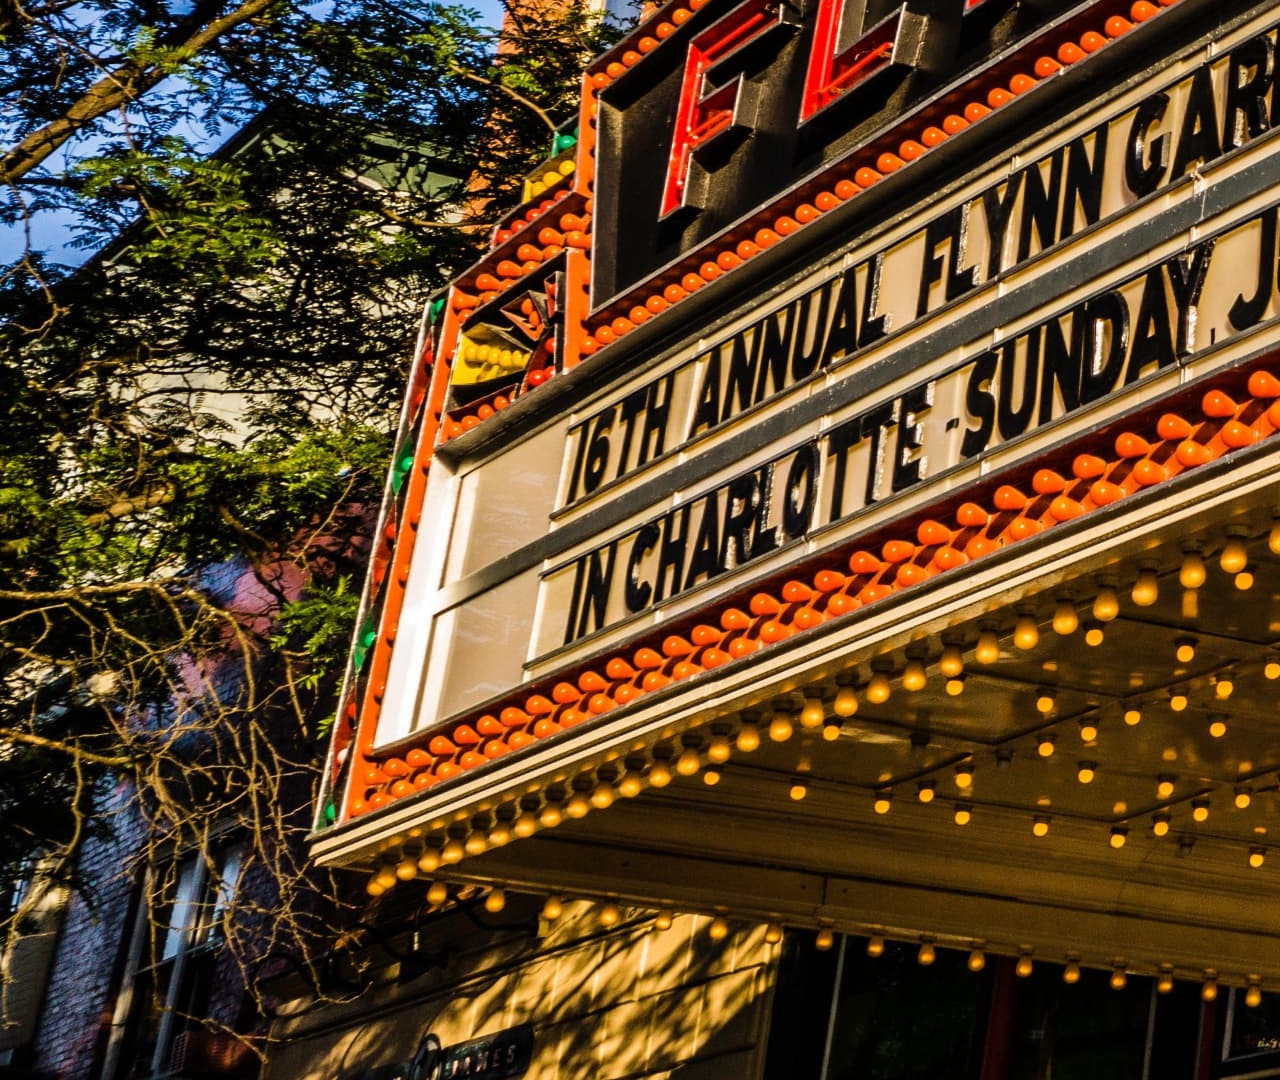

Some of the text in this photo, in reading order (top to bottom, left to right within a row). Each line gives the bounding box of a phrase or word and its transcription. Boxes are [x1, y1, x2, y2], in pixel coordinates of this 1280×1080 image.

[565, 373, 674, 506] 16TH
[692, 252, 890, 431] ANNUAL
[916, 126, 1108, 319] FLYNN
[563, 548, 618, 645] IN
[624, 380, 936, 613] CHARLOTTE
